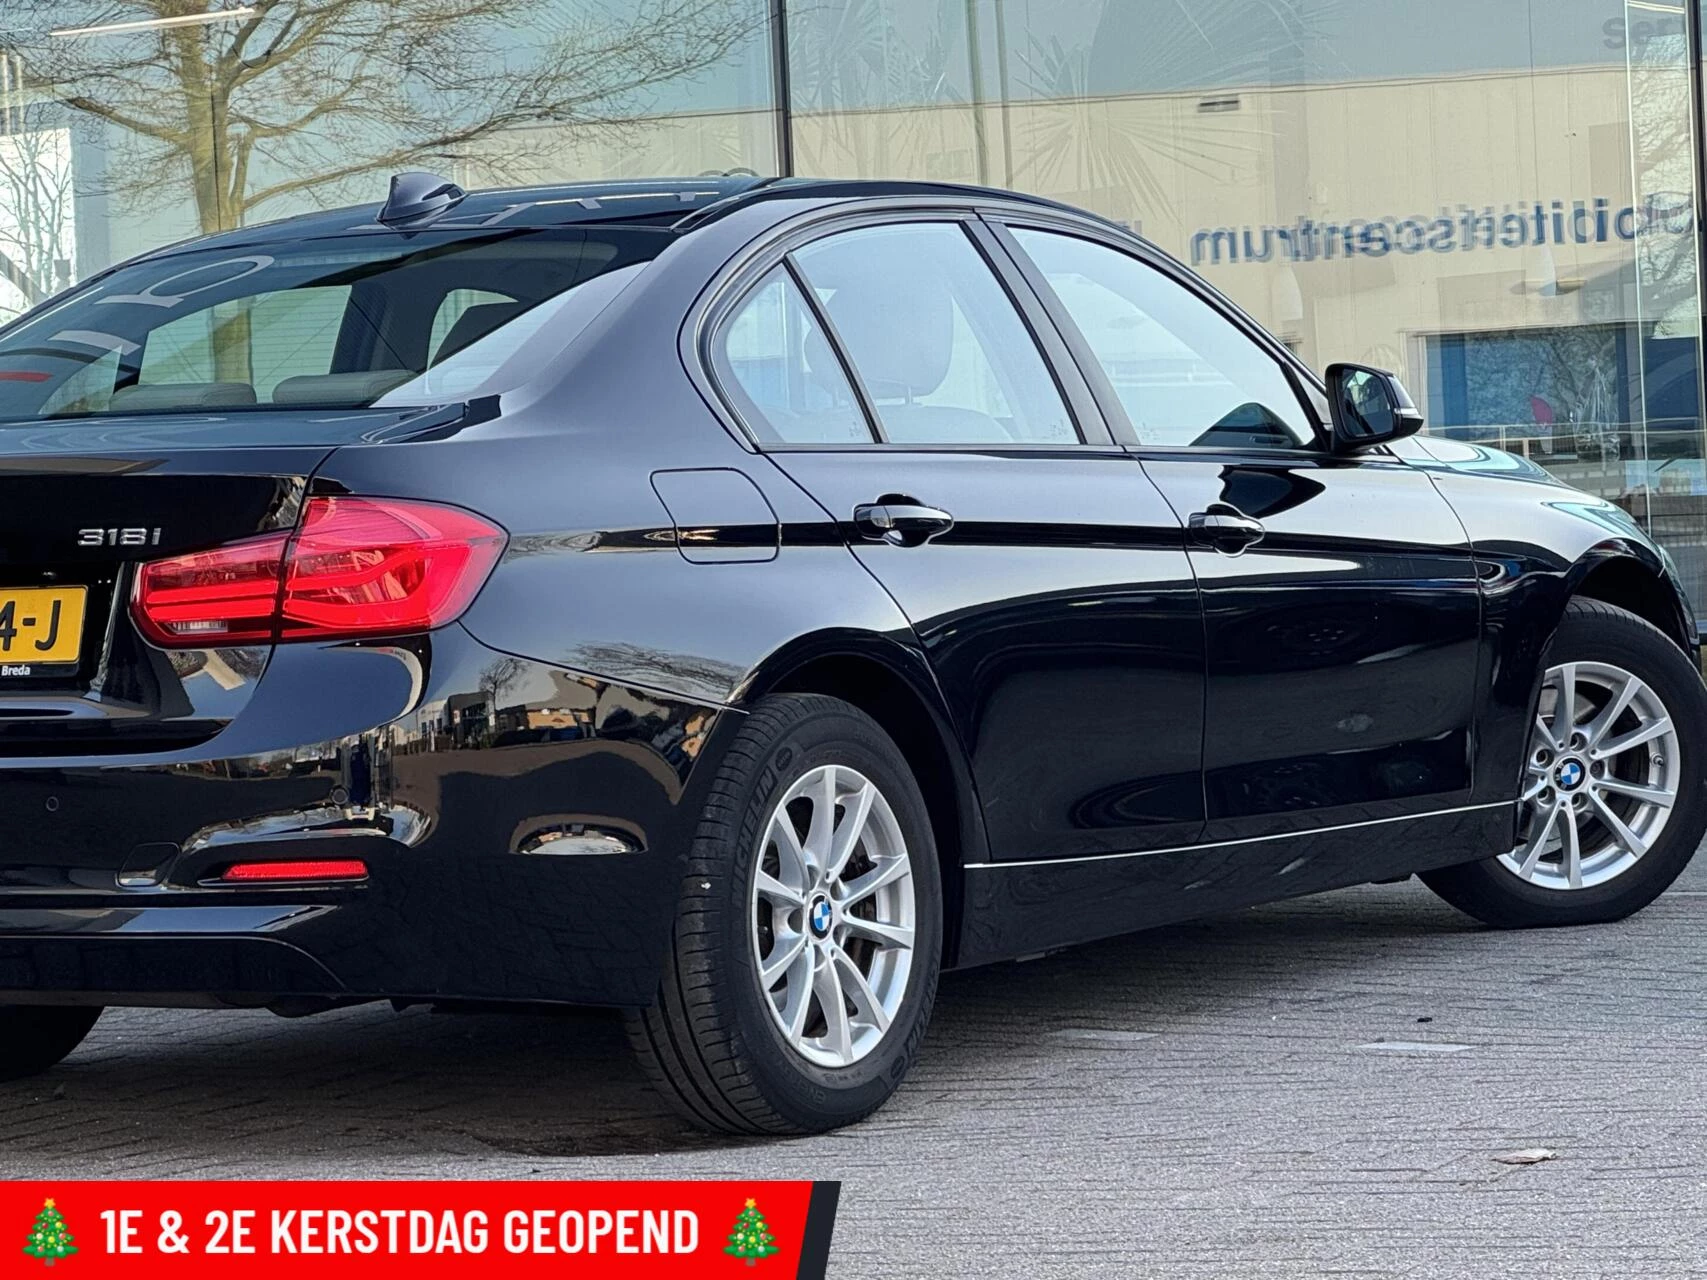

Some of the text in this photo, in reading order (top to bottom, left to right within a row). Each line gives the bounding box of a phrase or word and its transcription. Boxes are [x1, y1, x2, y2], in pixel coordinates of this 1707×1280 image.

[77, 527, 162, 546] 318i
[0, 599, 61, 651] 4-J
[1, 664, 31, 676] Breda
[730, 765, 777, 908] MICHELIN
